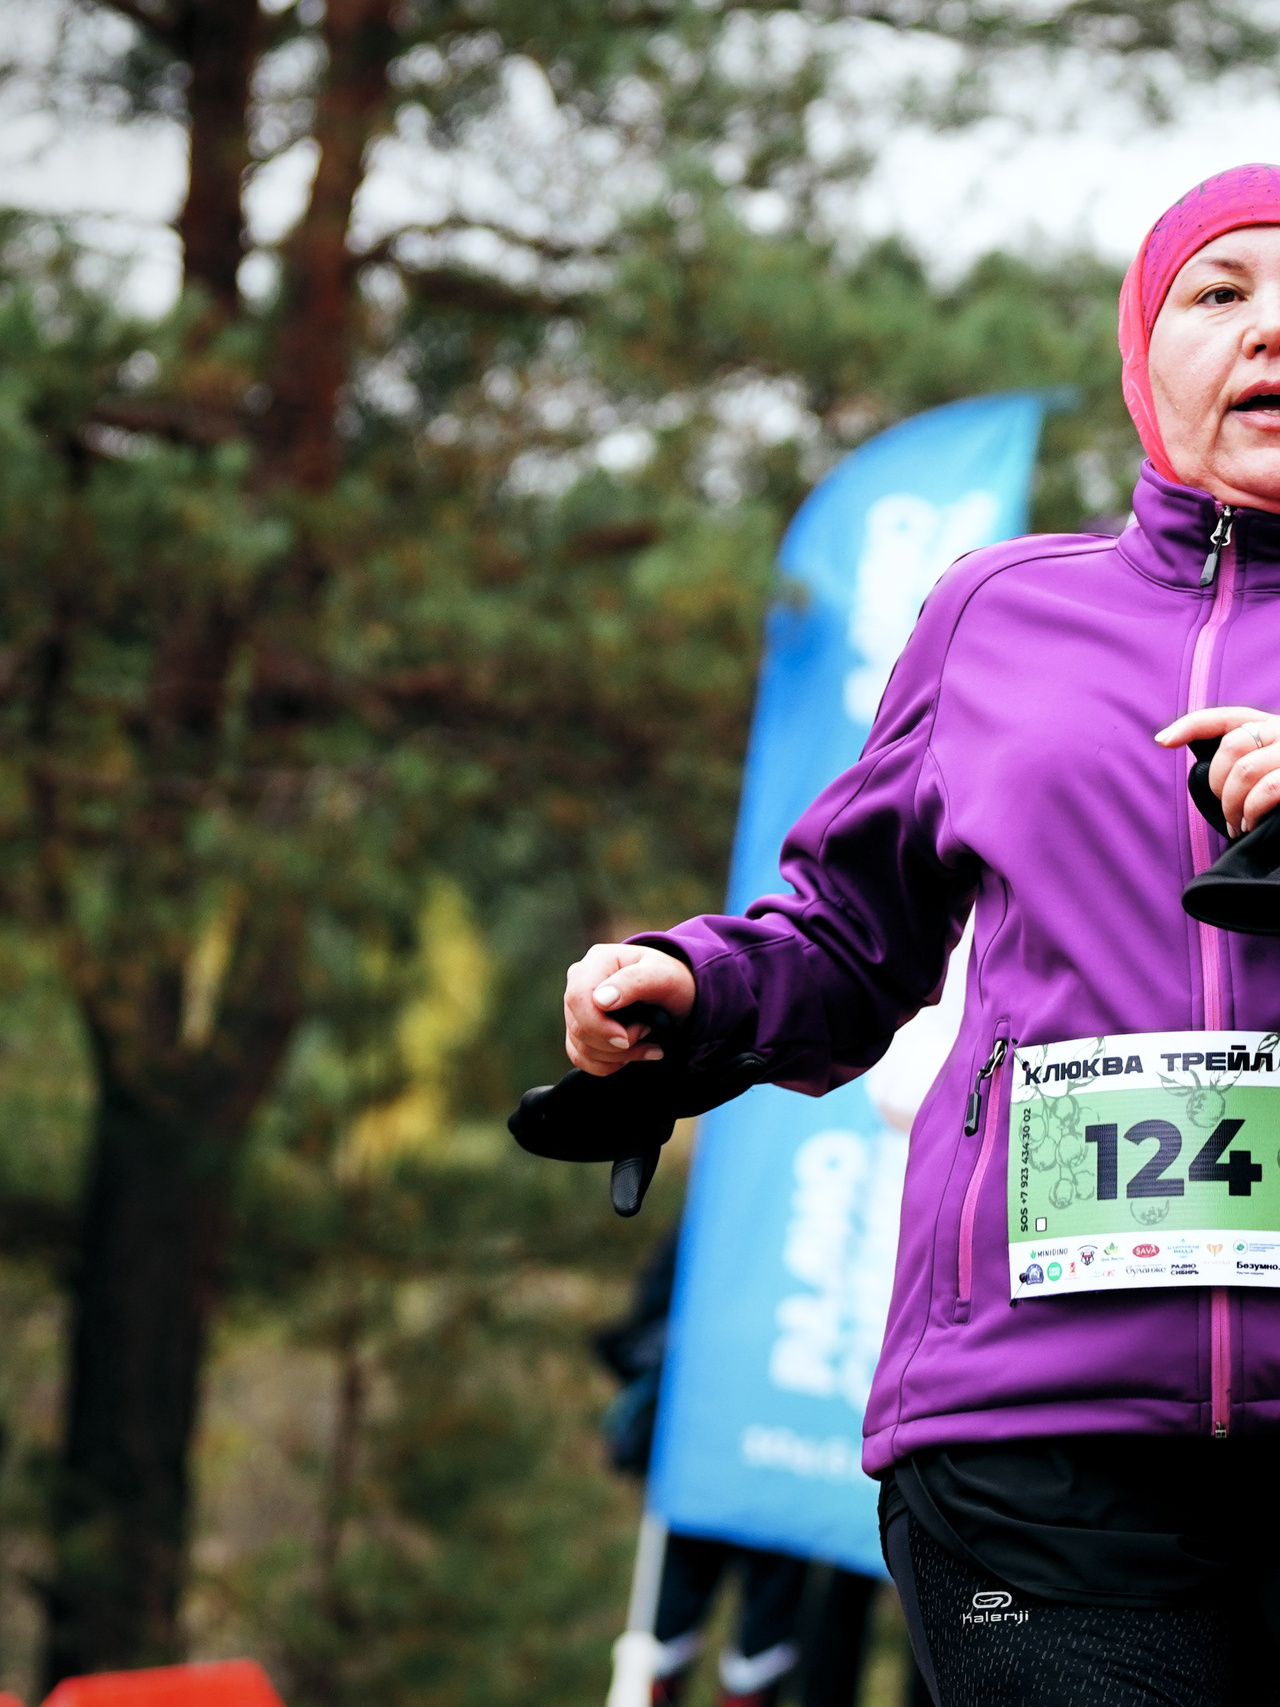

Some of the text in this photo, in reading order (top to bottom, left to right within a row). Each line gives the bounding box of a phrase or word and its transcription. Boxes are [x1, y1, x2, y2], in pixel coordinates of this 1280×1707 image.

[1025, 1045, 1273, 1086] КЛЮКВА ТРЕЙЛ
[1085, 1119, 1262, 1200] 124
[1020, 1107, 1031, 1232] SOS +7 923 434 30 02
[1037, 1247, 1069, 1258] MINIDINO
[1135, 1245, 1157, 1256] SAVA
[1236, 1261, 1280, 1271] Безумно.
[962, 1610, 1029, 1628] Kalenji
